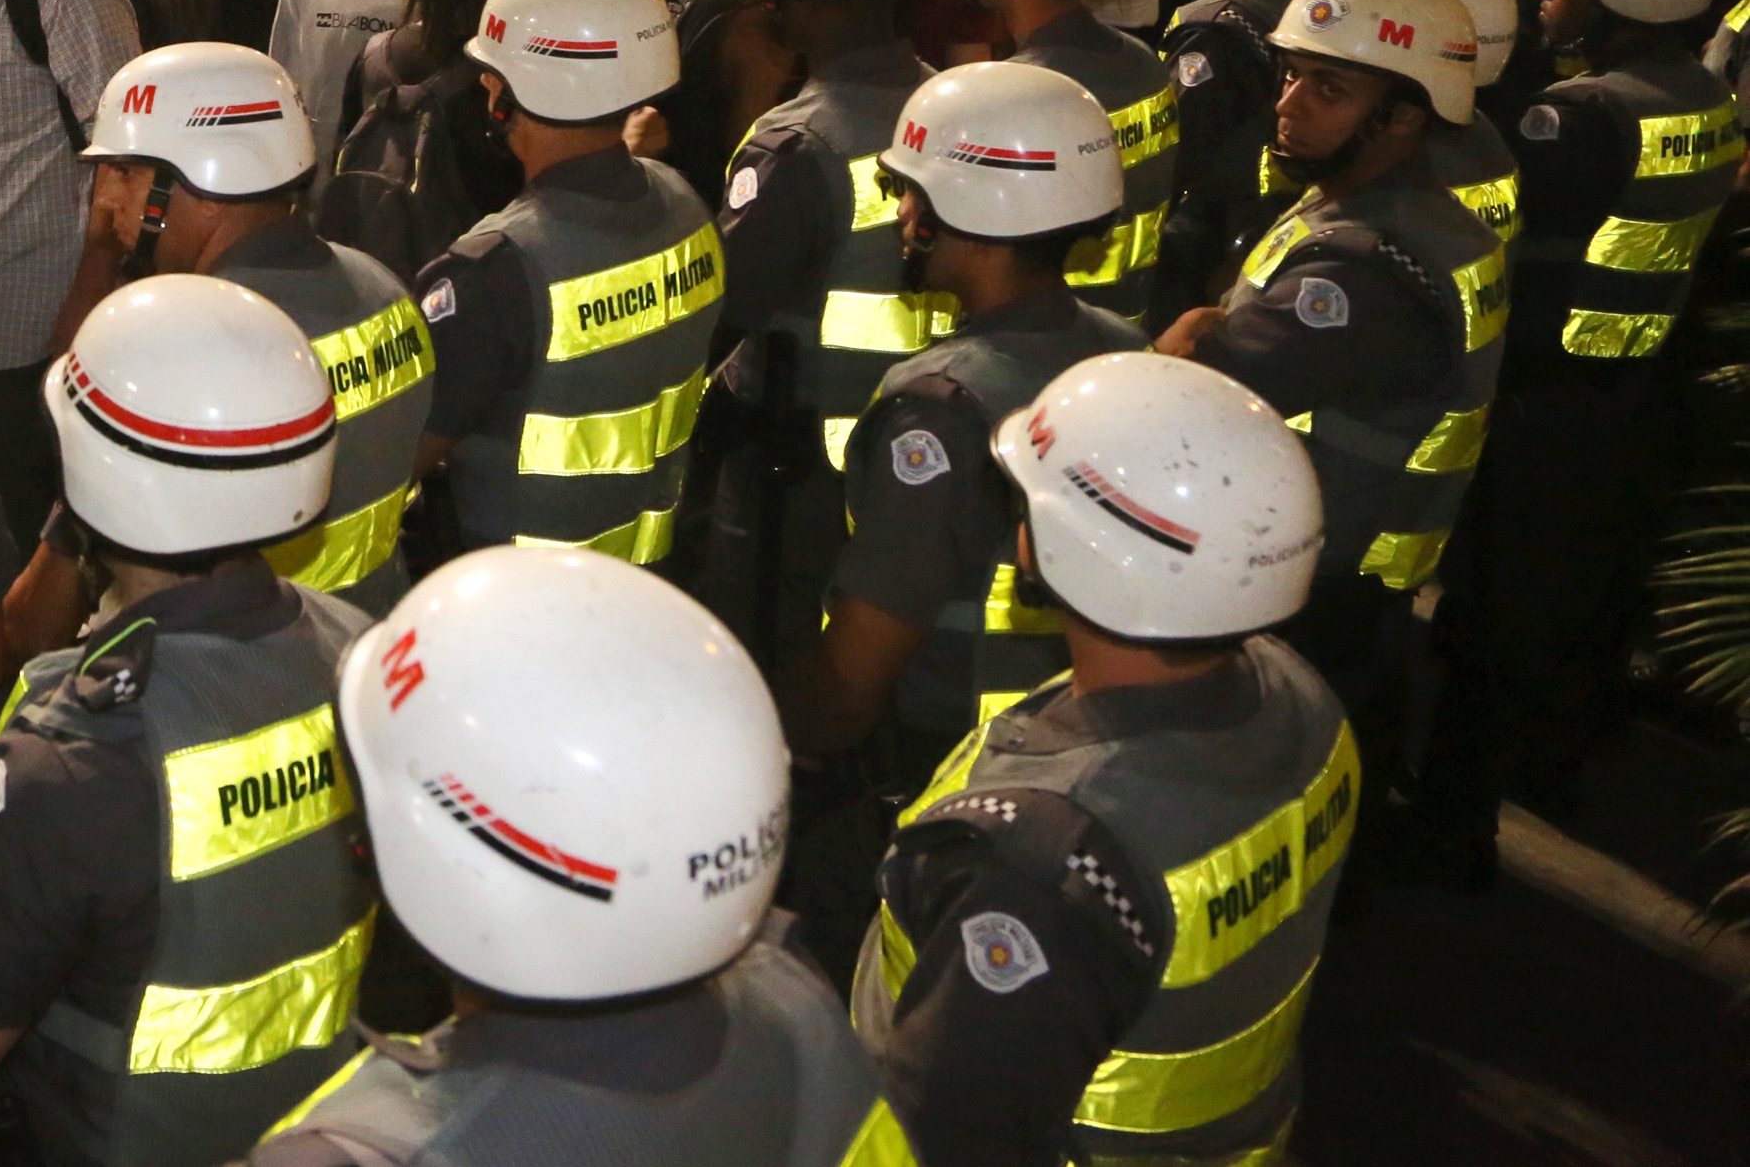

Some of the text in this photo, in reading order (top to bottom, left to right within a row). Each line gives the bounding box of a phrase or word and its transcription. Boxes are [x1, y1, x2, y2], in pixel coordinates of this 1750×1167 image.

[485, 13, 506, 45] M
[1377, 18, 1415, 50] M
[122, 84, 157, 115] M
[902, 121, 927, 153] M
[578, 251, 715, 332] POLICIA MILITAR
[327, 325, 423, 396] ICIA MILITAR
[380, 628, 427, 714] M
[218, 749, 336, 826] POLICIA
[1207, 772, 1352, 939] POLICIA MILITAR
